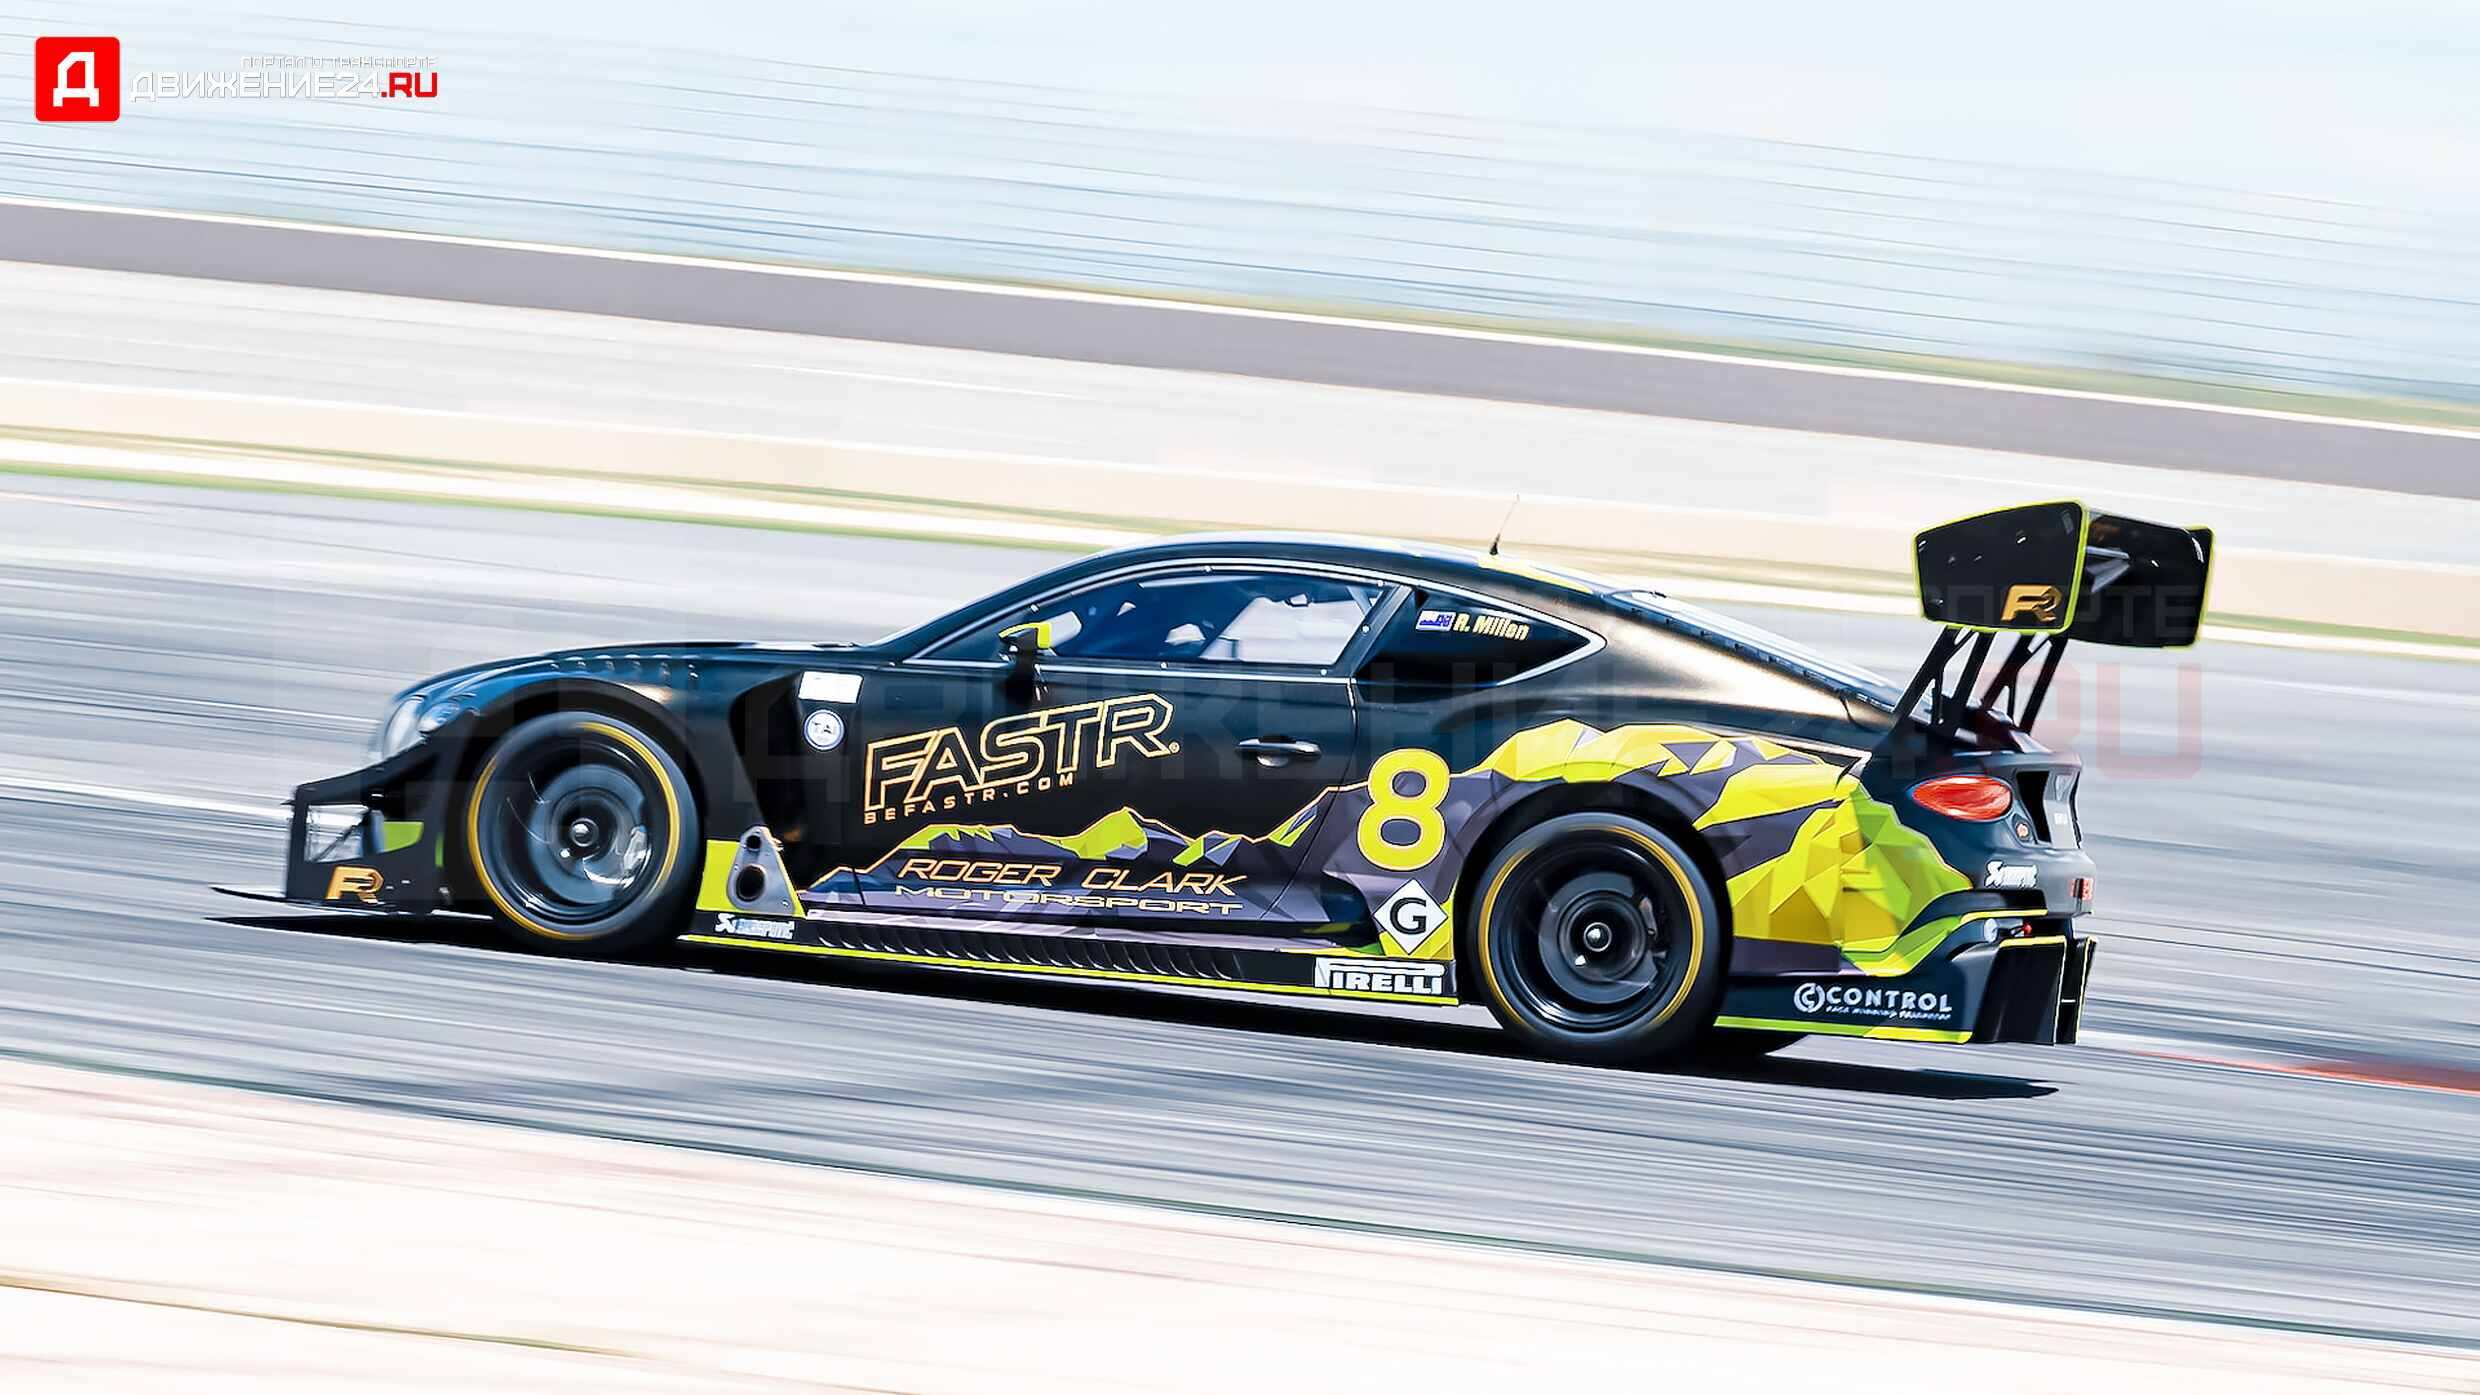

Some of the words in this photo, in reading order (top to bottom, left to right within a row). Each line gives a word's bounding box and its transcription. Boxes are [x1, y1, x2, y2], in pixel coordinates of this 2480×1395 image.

[864, 772, 1074, 825] BEFASTR.COM
[1357, 747, 1450, 872] 8
[898, 857, 1062, 886] ROGER
[1081, 868, 1248, 896] CLARK
[895, 885, 1244, 915] MOTORSPORT
[1389, 897, 1428, 936] G
[1315, 957, 1447, 994] PIRELLI
[1826, 986, 1952, 1012] CONTROL
